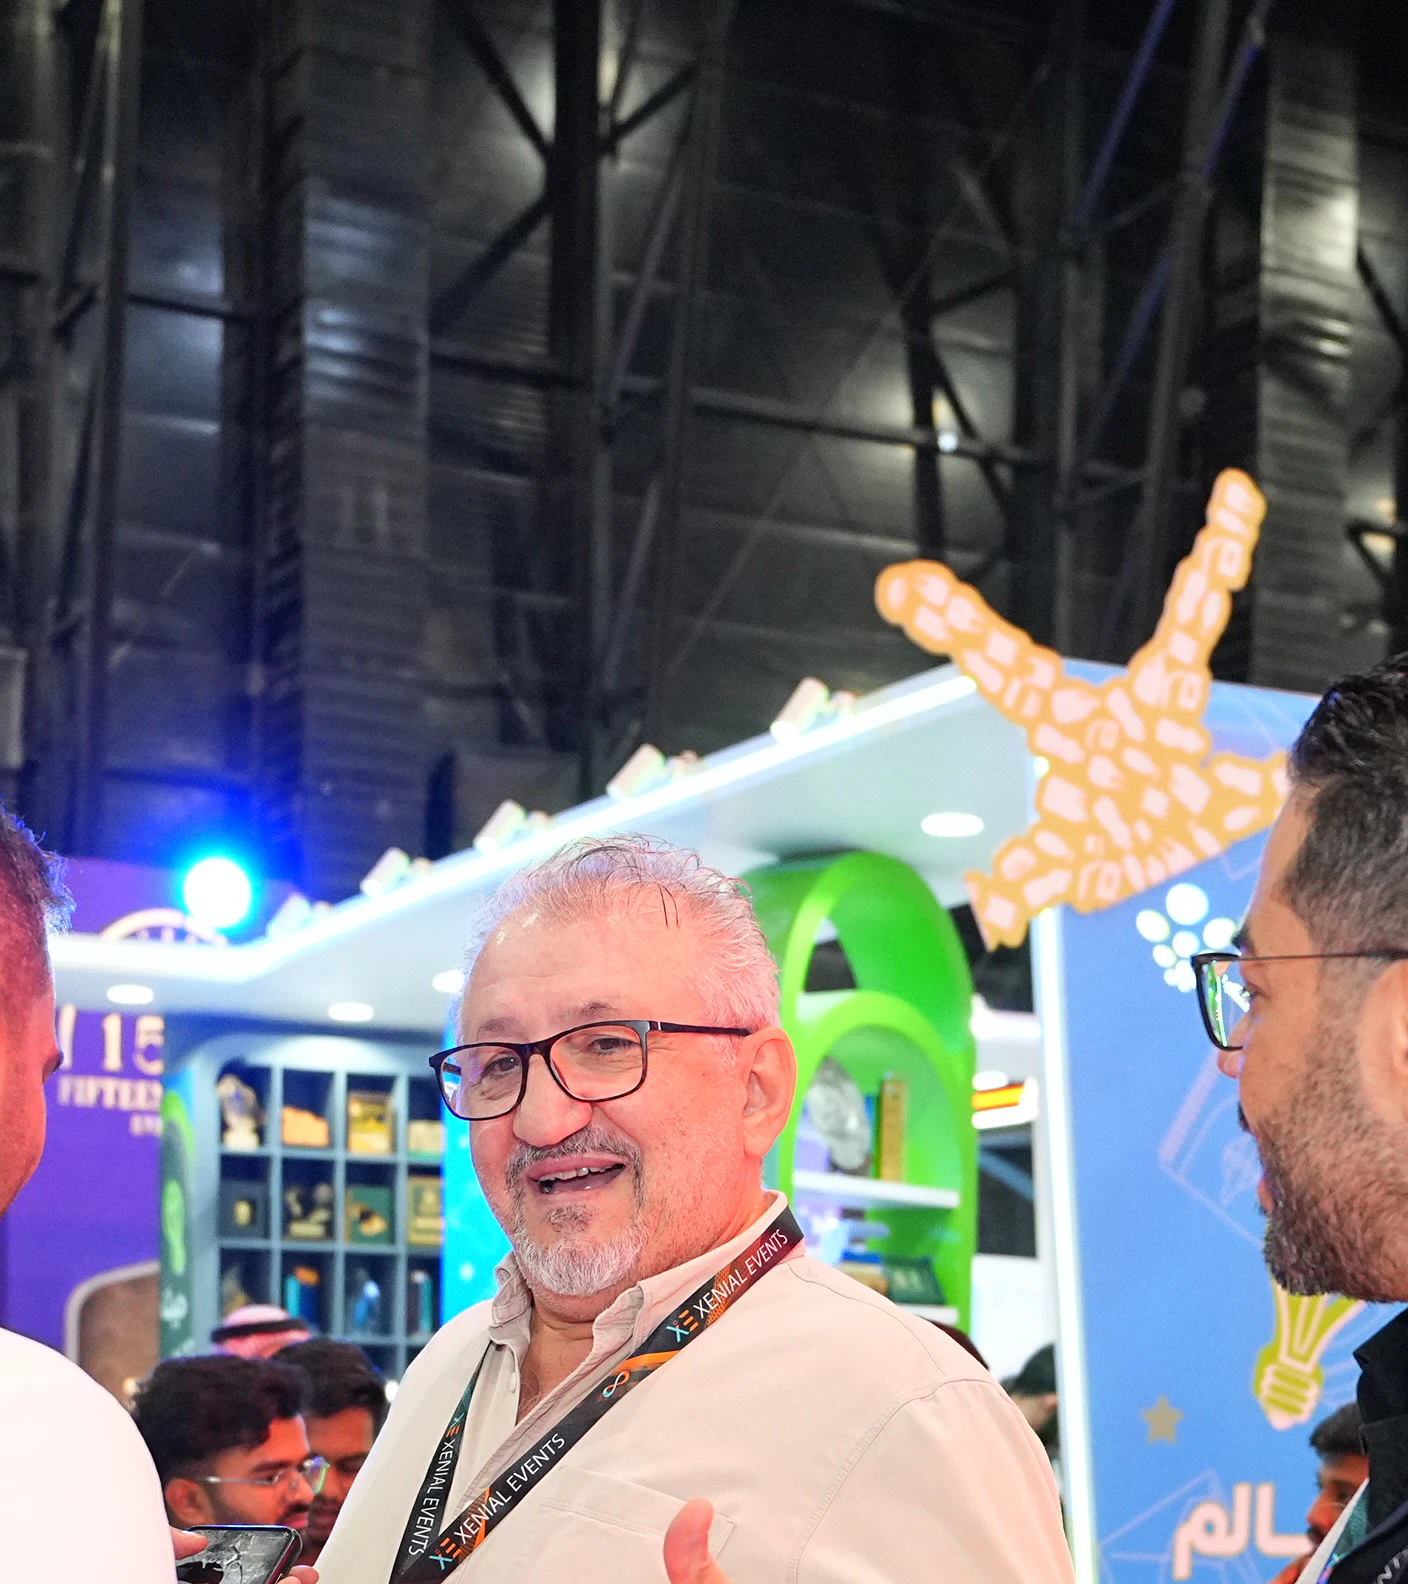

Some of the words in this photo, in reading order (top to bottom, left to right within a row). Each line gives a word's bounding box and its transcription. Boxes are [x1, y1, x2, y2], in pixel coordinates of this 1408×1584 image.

[693, 1268, 748, 1320] XENIAL
[744, 1228, 789, 1276] EVENTS
[428, 1438, 456, 1496] XENIAL
[453, 1486, 512, 1545] XENIAL
[506, 1433, 566, 1493] EVENTS
[407, 1496, 440, 1556] EVENTS
[1172, 1481, 1316, 1582] الم
